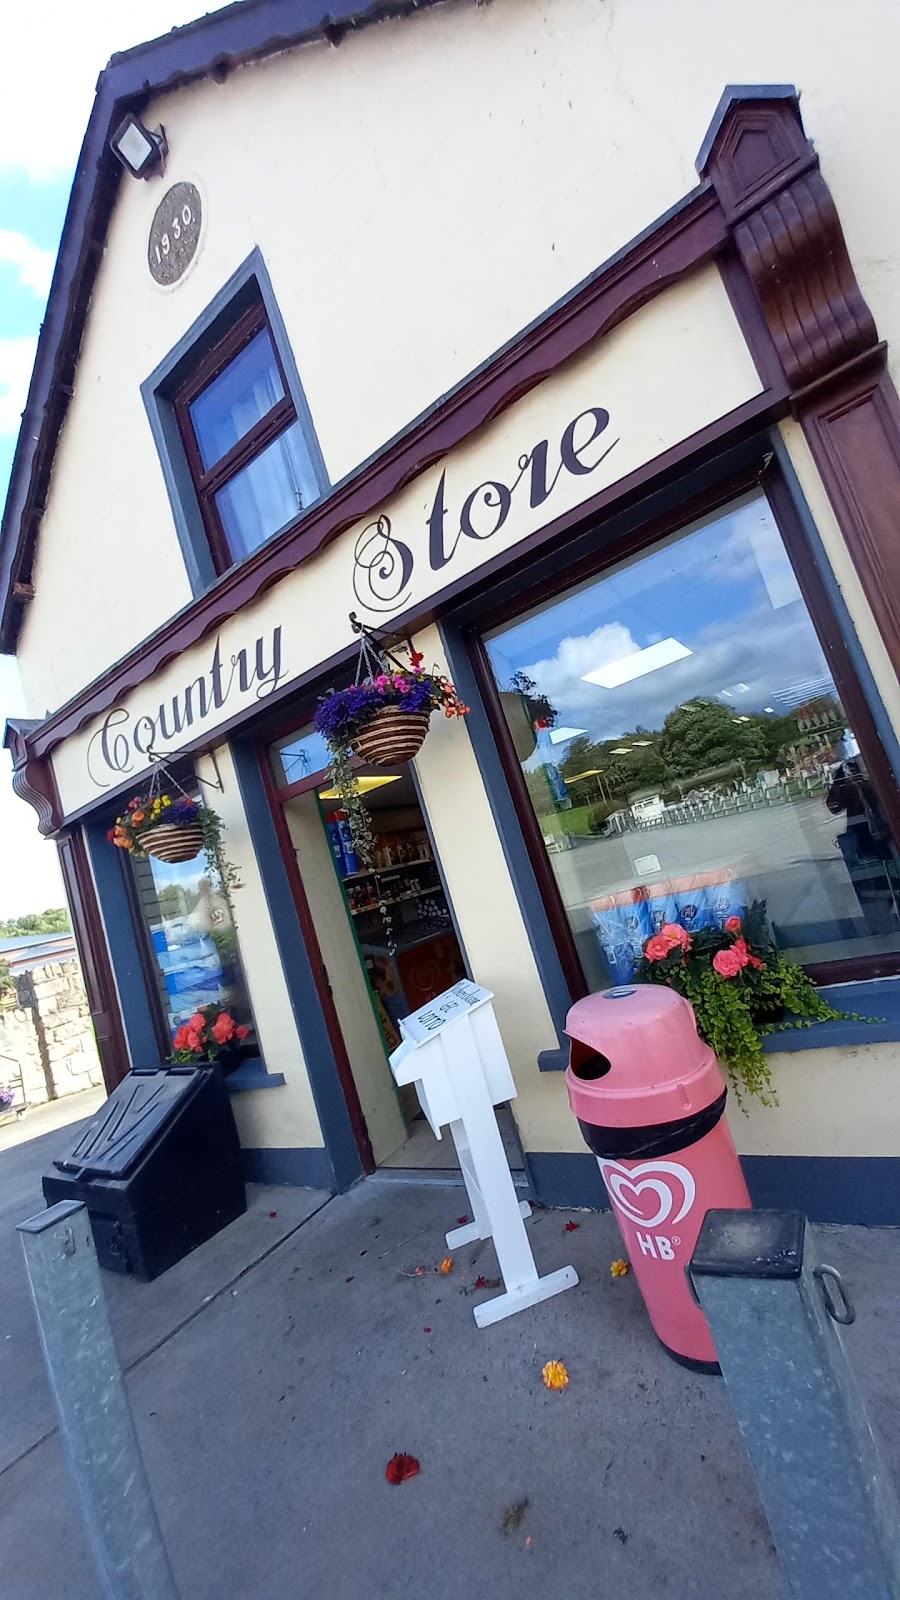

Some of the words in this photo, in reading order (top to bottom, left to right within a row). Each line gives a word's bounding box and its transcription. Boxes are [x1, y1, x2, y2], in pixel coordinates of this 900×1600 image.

[155, 204, 191, 264] 1930
[87, 624, 289, 788] Country
[352, 407, 621, 613] Store
